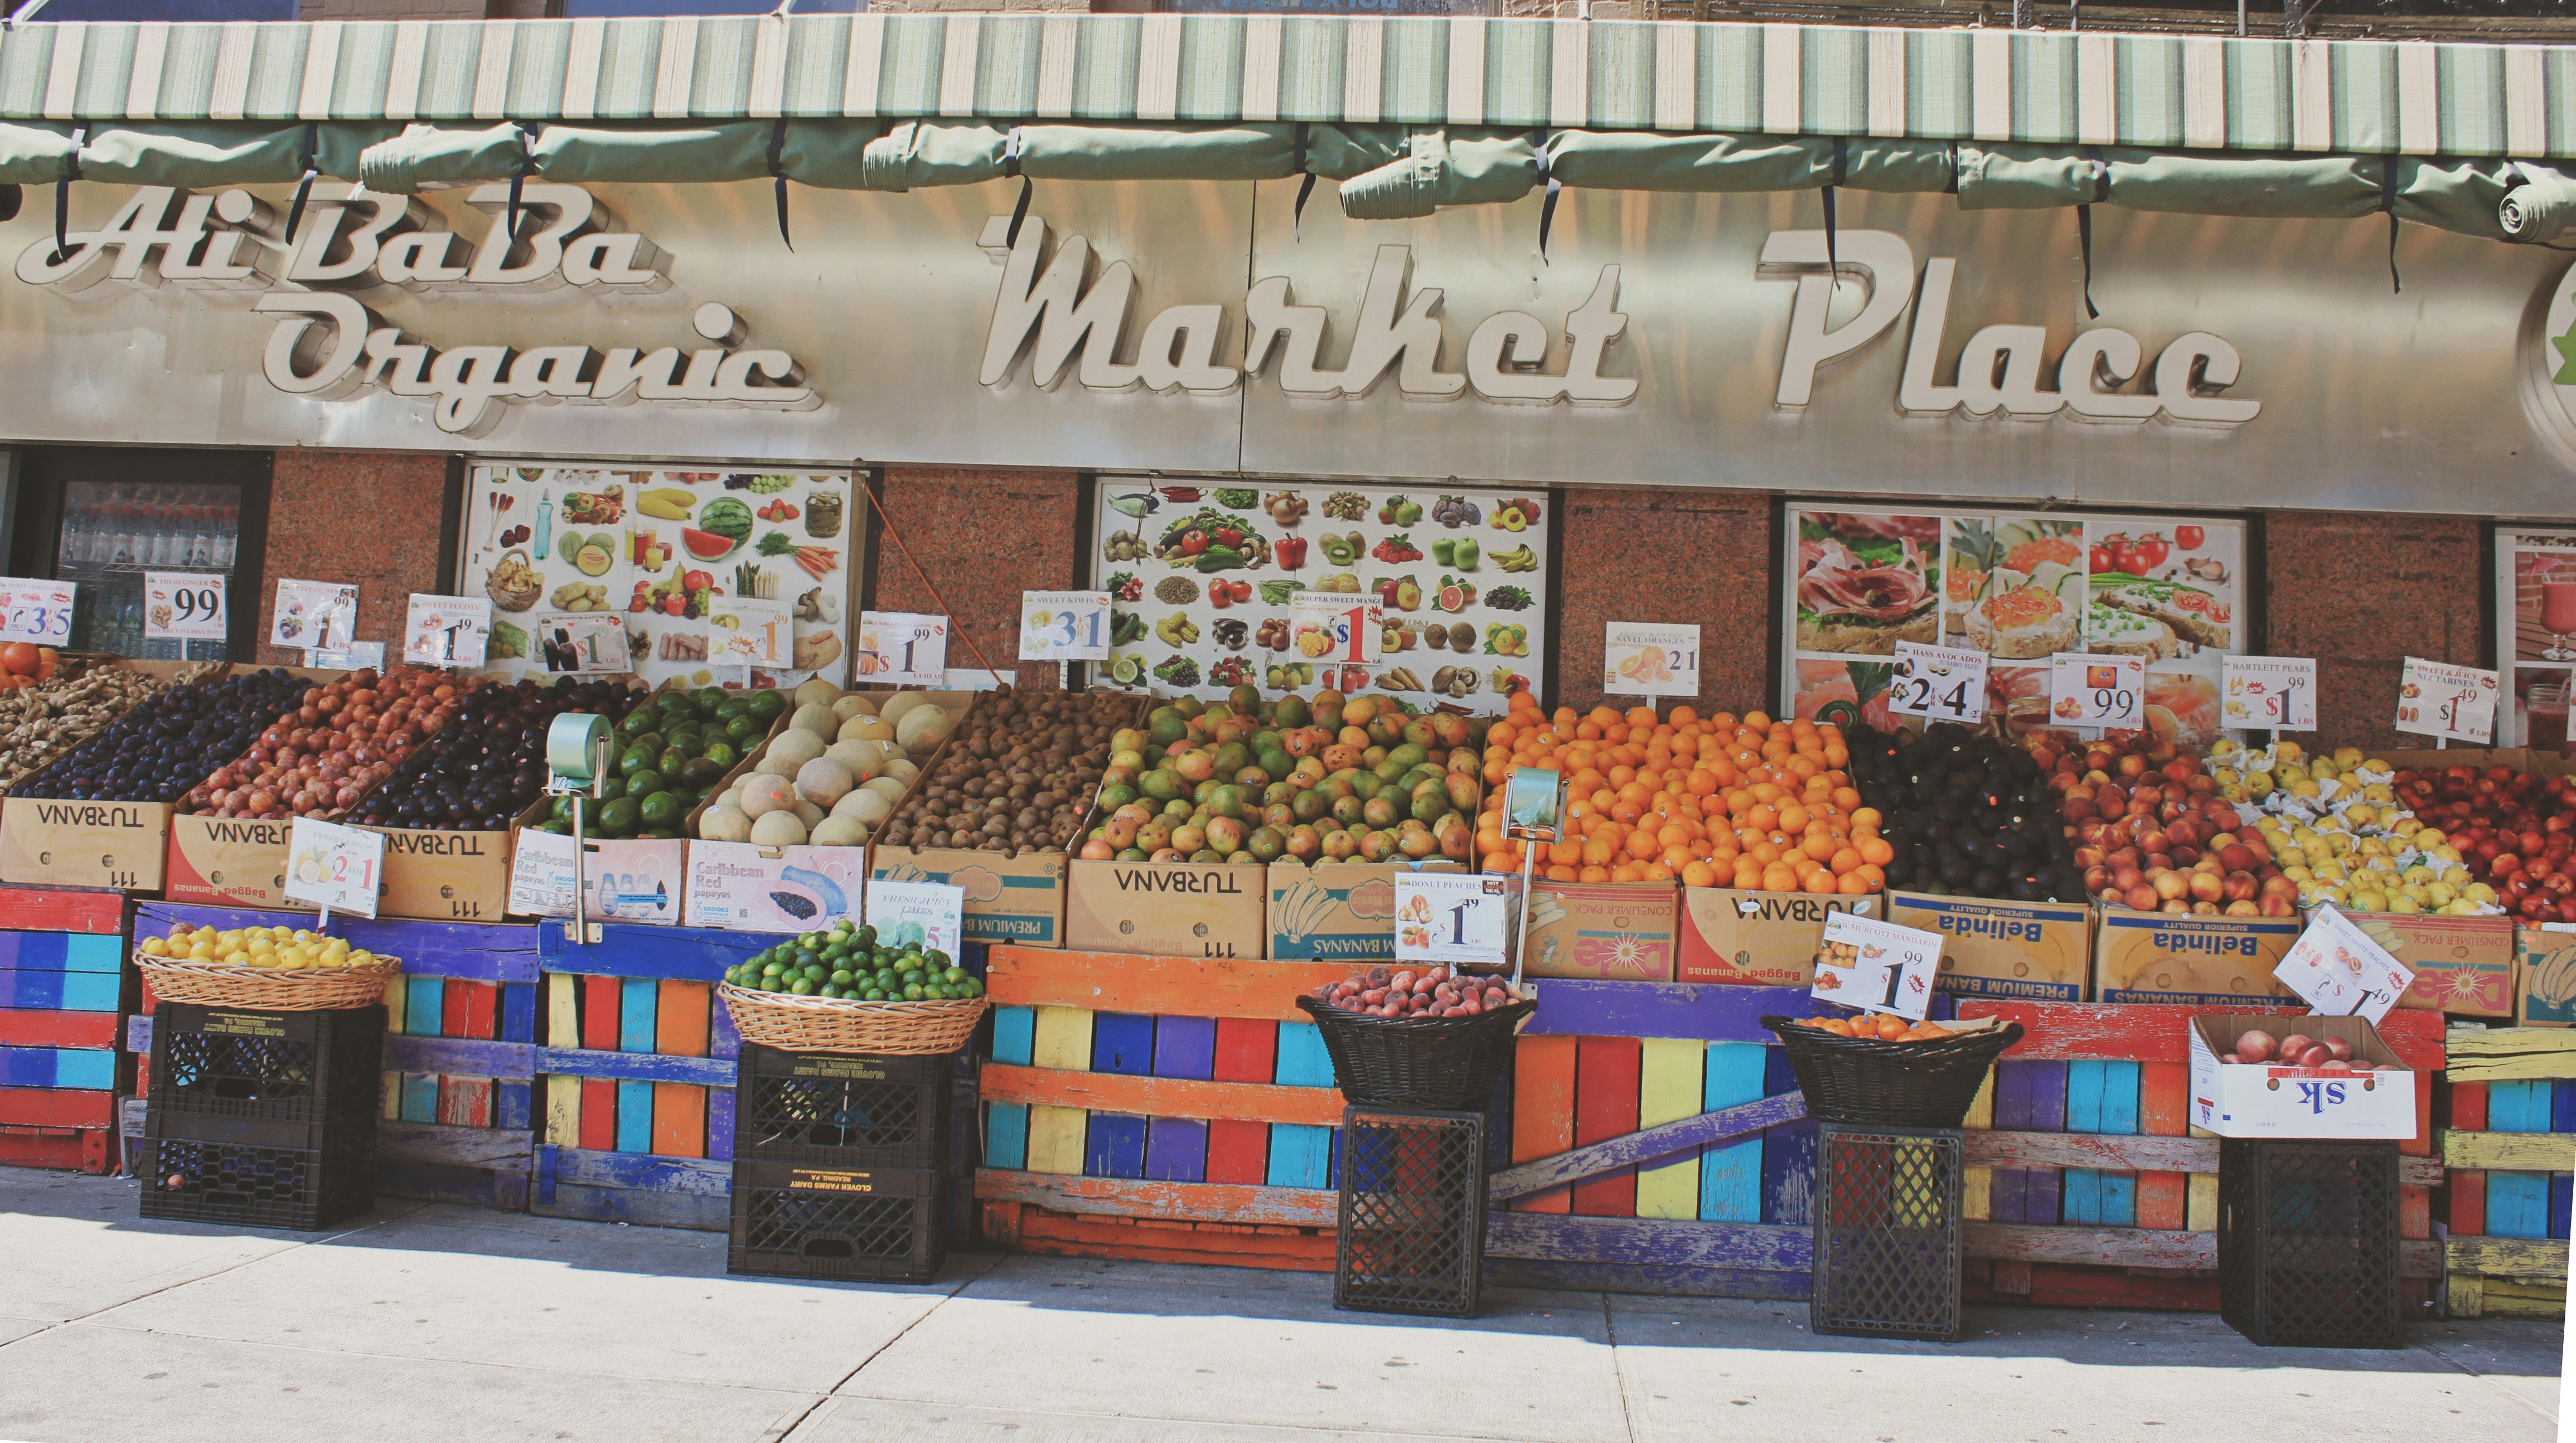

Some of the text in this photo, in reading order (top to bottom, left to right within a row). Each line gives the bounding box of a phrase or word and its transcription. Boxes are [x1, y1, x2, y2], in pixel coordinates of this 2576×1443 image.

[976, 215, 2262, 421] Market Place
[252, 293, 814, 434] Organic
[1913, 649, 1982, 664] HASS AVOCADOS
[2233, 663, 2280, 671] BARTLETT
[2418, 665, 2444, 675] SWEET
[2454, 670, 2478, 680] JUICY
[2417, 672, 2475, 687] NECTARINES
[37, 803, 144, 828] TURBANA
[313, 831, 374, 849] FRESH LEMONS
[387, 832, 485, 856] TURBAN
[517, 847, 574, 867] Caribbean
[515, 860, 537, 874] Red
[696, 861, 764, 878] Caribbean
[111, 871, 138, 887] 111
[514, 874, 545, 885] papayas
[695, 874, 722, 889] Red
[1113, 869, 1242, 894] TURBANA
[1411, 879, 1441, 888] DONUT
[1444, 882, 1482, 890] PEACHES
[174, 884, 265, 898] Bagged Bananas
[694, 889, 732, 900] papayas
[883, 895, 953, 907] FRESH JUICY
[452, 900, 482, 918] 111
[901, 906, 934, 915] LIMES
[1575, 905, 1672, 916] CONSUMER PACK
[1949, 904, 2033, 918] SUPERIOR QUALITY
[979, 919, 1040, 934] PREMIUM
[1938, 915, 2042, 943] Belinda
[2204, 923, 2248, 932] SUPERIOR
[1851, 923, 1891, 938] MURCOTT
[1892, 933, 1938, 947] MANDARIN
[2413, 934, 2510, 947] CONSUMER PACK
[1134, 938, 1183, 951] Bagged
[1204, 942, 1236, 958] 111
[1314, 939, 1379, 953] BANANAS
[2153, 932, 2258, 956] Belinda
[2333, 923, 2390, 971] SWEET WHITE PEACHES
[1573, 937, 1669, 979] Dole
[1687, 967, 1801, 981] Bagged Bananas
[1987, 980, 2069, 998] PREMIUM
[2413, 967, 2507, 1011] Dole
[227, 1025, 253, 1034] FARMS
[255, 1027, 285, 1037] CLOVER
[821, 1068, 849, 1077] FARMS
[851, 1070, 885, 1079] CLOVER
